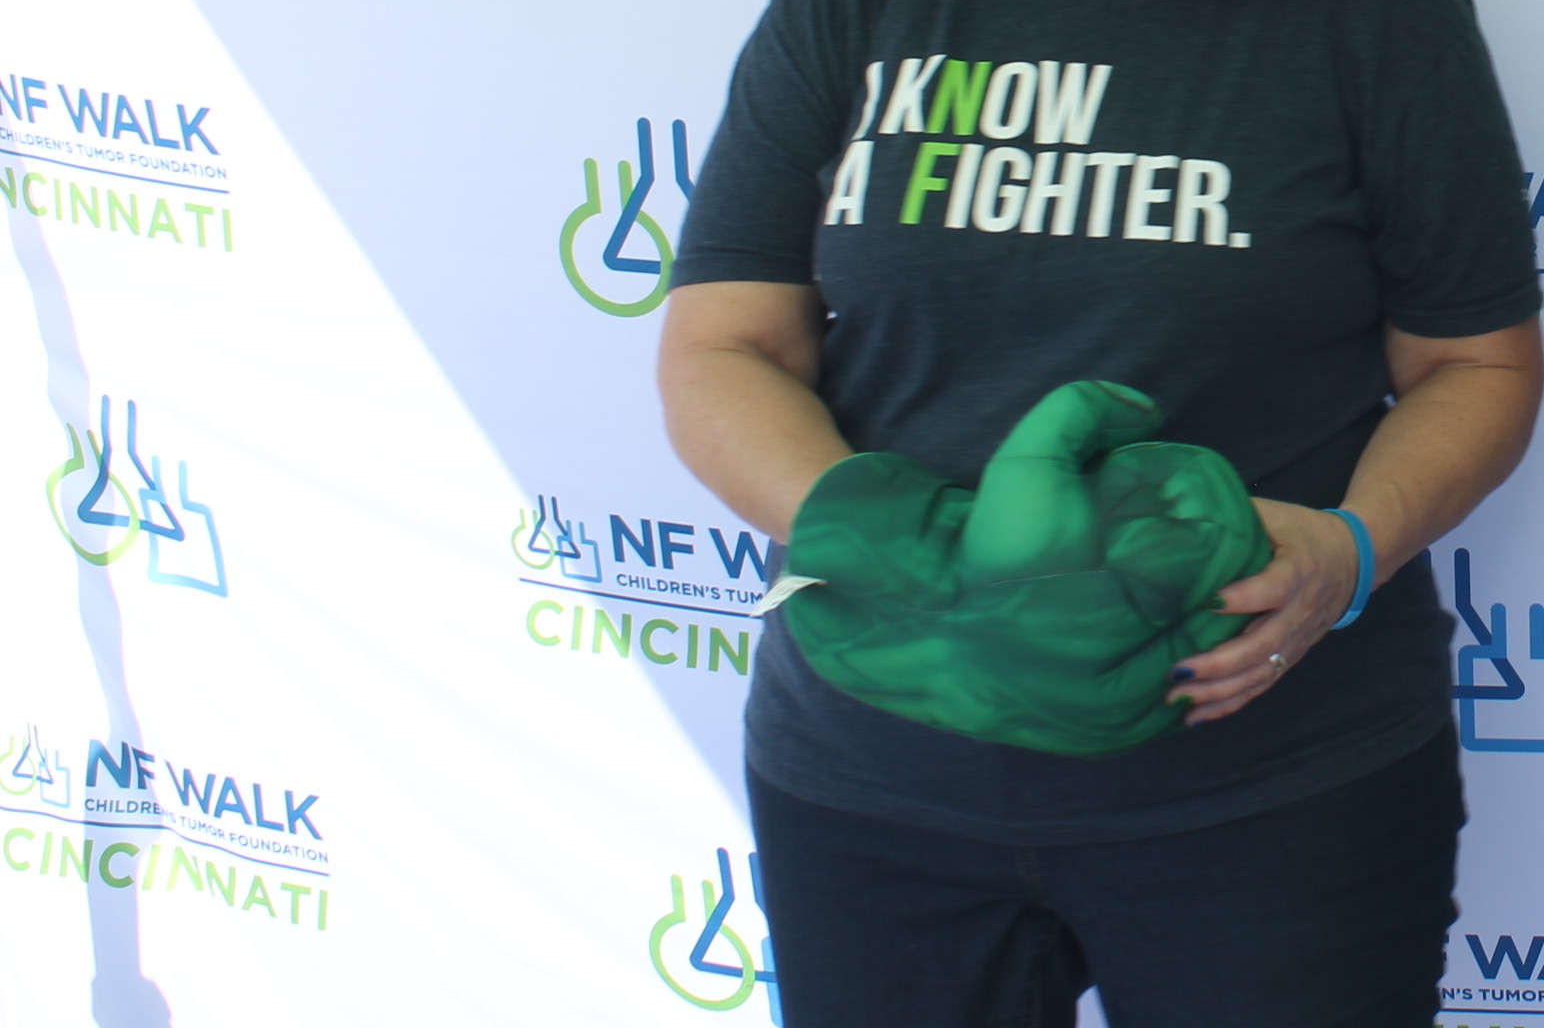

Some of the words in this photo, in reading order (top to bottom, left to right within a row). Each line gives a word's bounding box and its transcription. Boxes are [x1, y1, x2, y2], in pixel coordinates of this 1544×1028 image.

[0, 73, 48, 123] NF
[57, 83, 221, 156] WALK
[878, 54, 1113, 145] KNOW
[0, 127, 73, 153] CHILDREN'S
[76, 143, 125, 164] TUMOR
[130, 153, 227, 180] FOUNDATION
[823, 140, 875, 226] A
[900, 142, 1251, 248] FIGHTER.
[609, 514, 695, 570] NF
[616, 574, 720, 600] CHILDREN'S
[86, 739, 155, 789] NF
[164, 760, 324, 840] WALK
[3, 827, 328, 931] CINCINNATI
[180, 816, 226, 840] TUMOR
[229, 832, 329, 864] FOUNDATION
